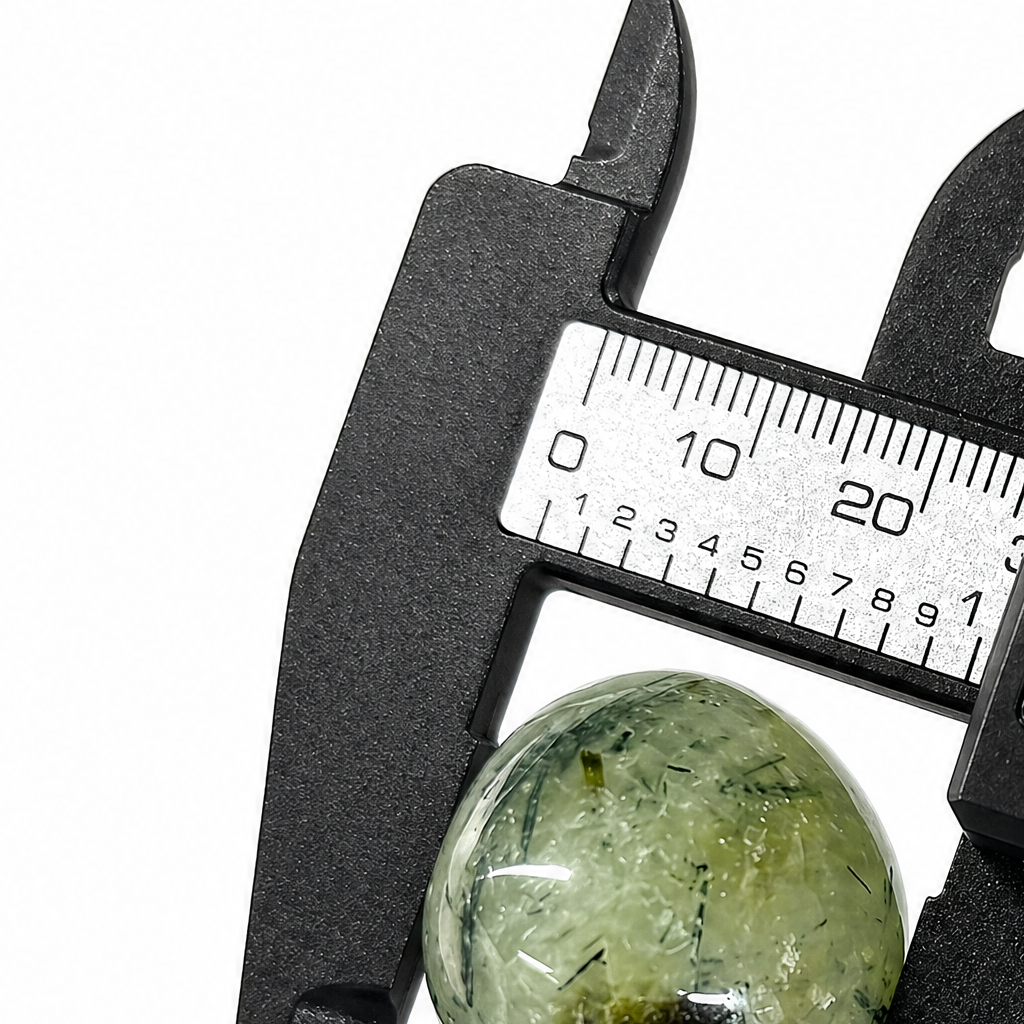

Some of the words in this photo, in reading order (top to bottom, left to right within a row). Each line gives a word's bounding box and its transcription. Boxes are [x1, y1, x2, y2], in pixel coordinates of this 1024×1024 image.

[546, 428, 589, 474] 0
[675, 429, 742, 483] 10
[829, 479, 915, 538] 20
[574, 492, 589, 517] 1
[611, 503, 637, 532] 2
[654, 517, 679, 544] 3
[696, 533, 721, 558] 4
[739, 544, 766, 573] 5
[783, 558, 809, 587] 6
[830, 571, 854, 598] 7
[869, 586, 897, 614] 8
[914, 601, 940, 629] 9
[960, 589, 984, 628] 1
